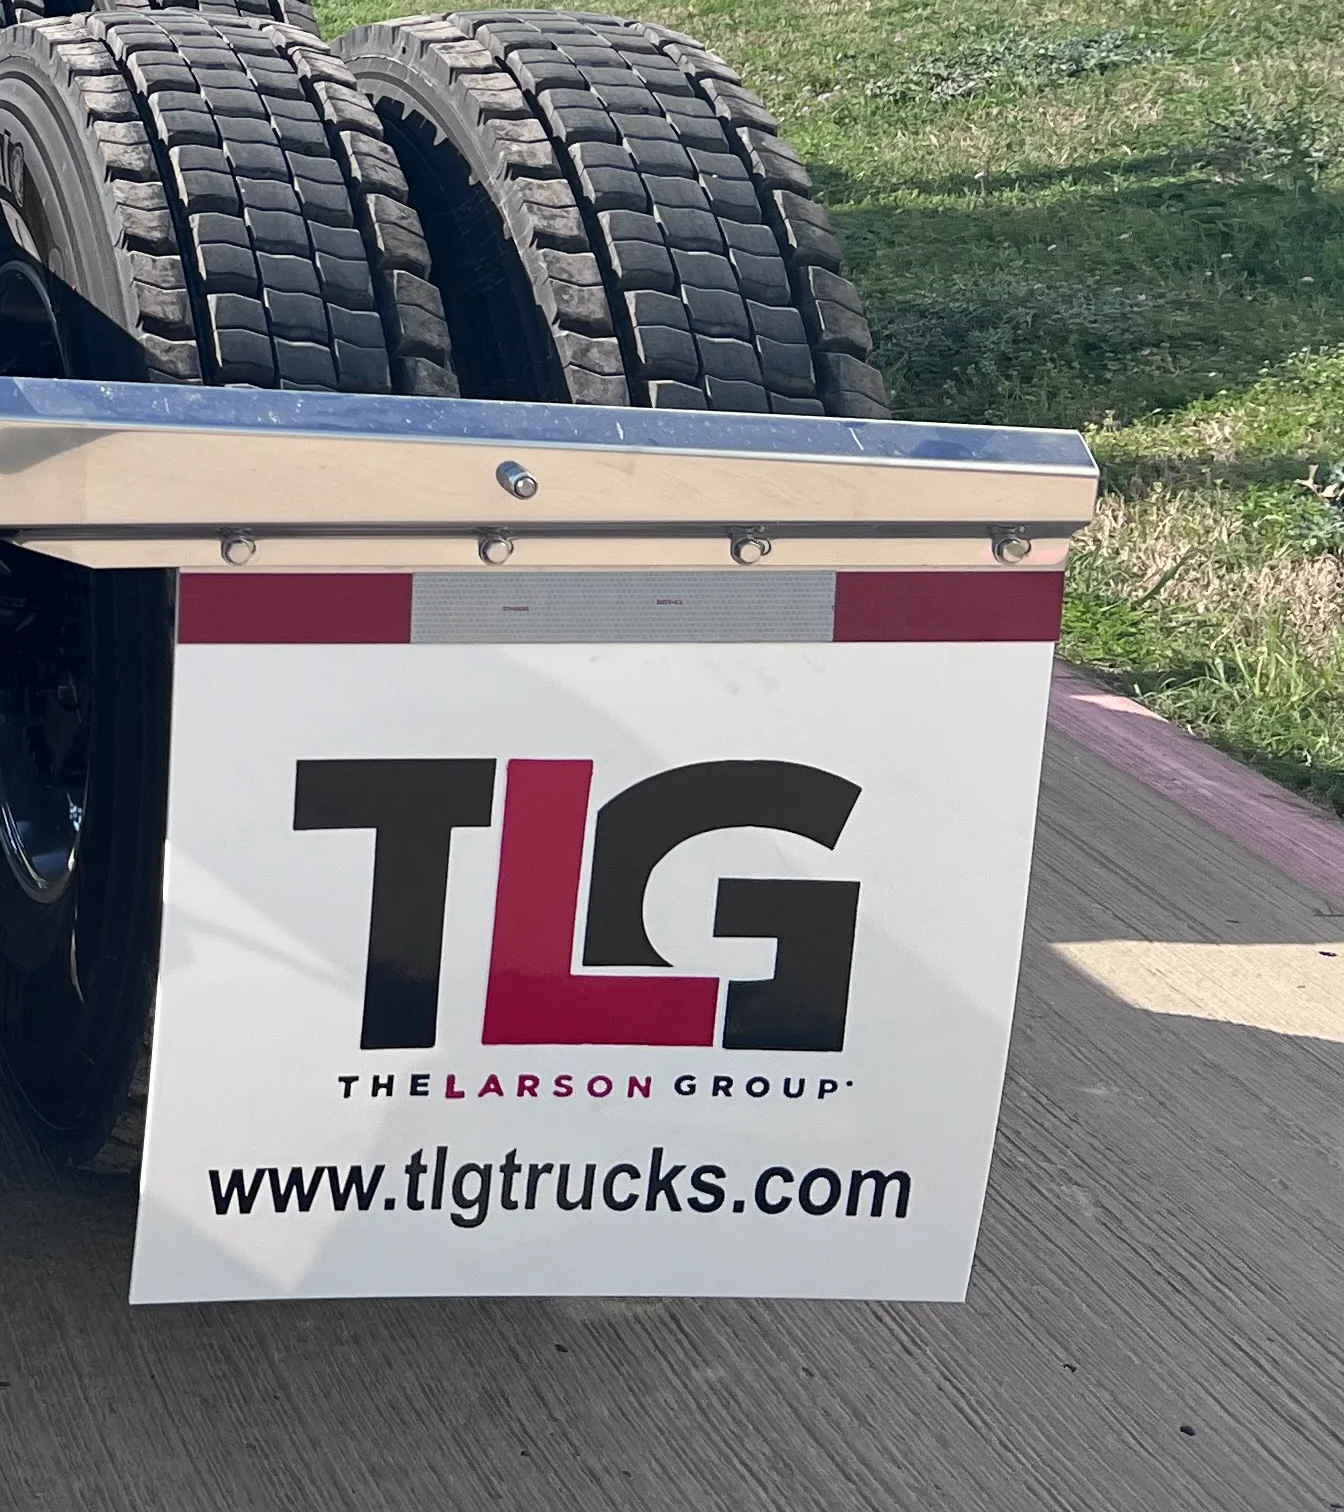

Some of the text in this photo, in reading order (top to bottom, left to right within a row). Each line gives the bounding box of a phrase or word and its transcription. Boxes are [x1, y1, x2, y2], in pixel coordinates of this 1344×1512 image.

[292, 757, 863, 1053] TLG
[673, 1074, 840, 1100] GROUP
[208, 1145, 911, 1229] www.tlgtrucks.com
